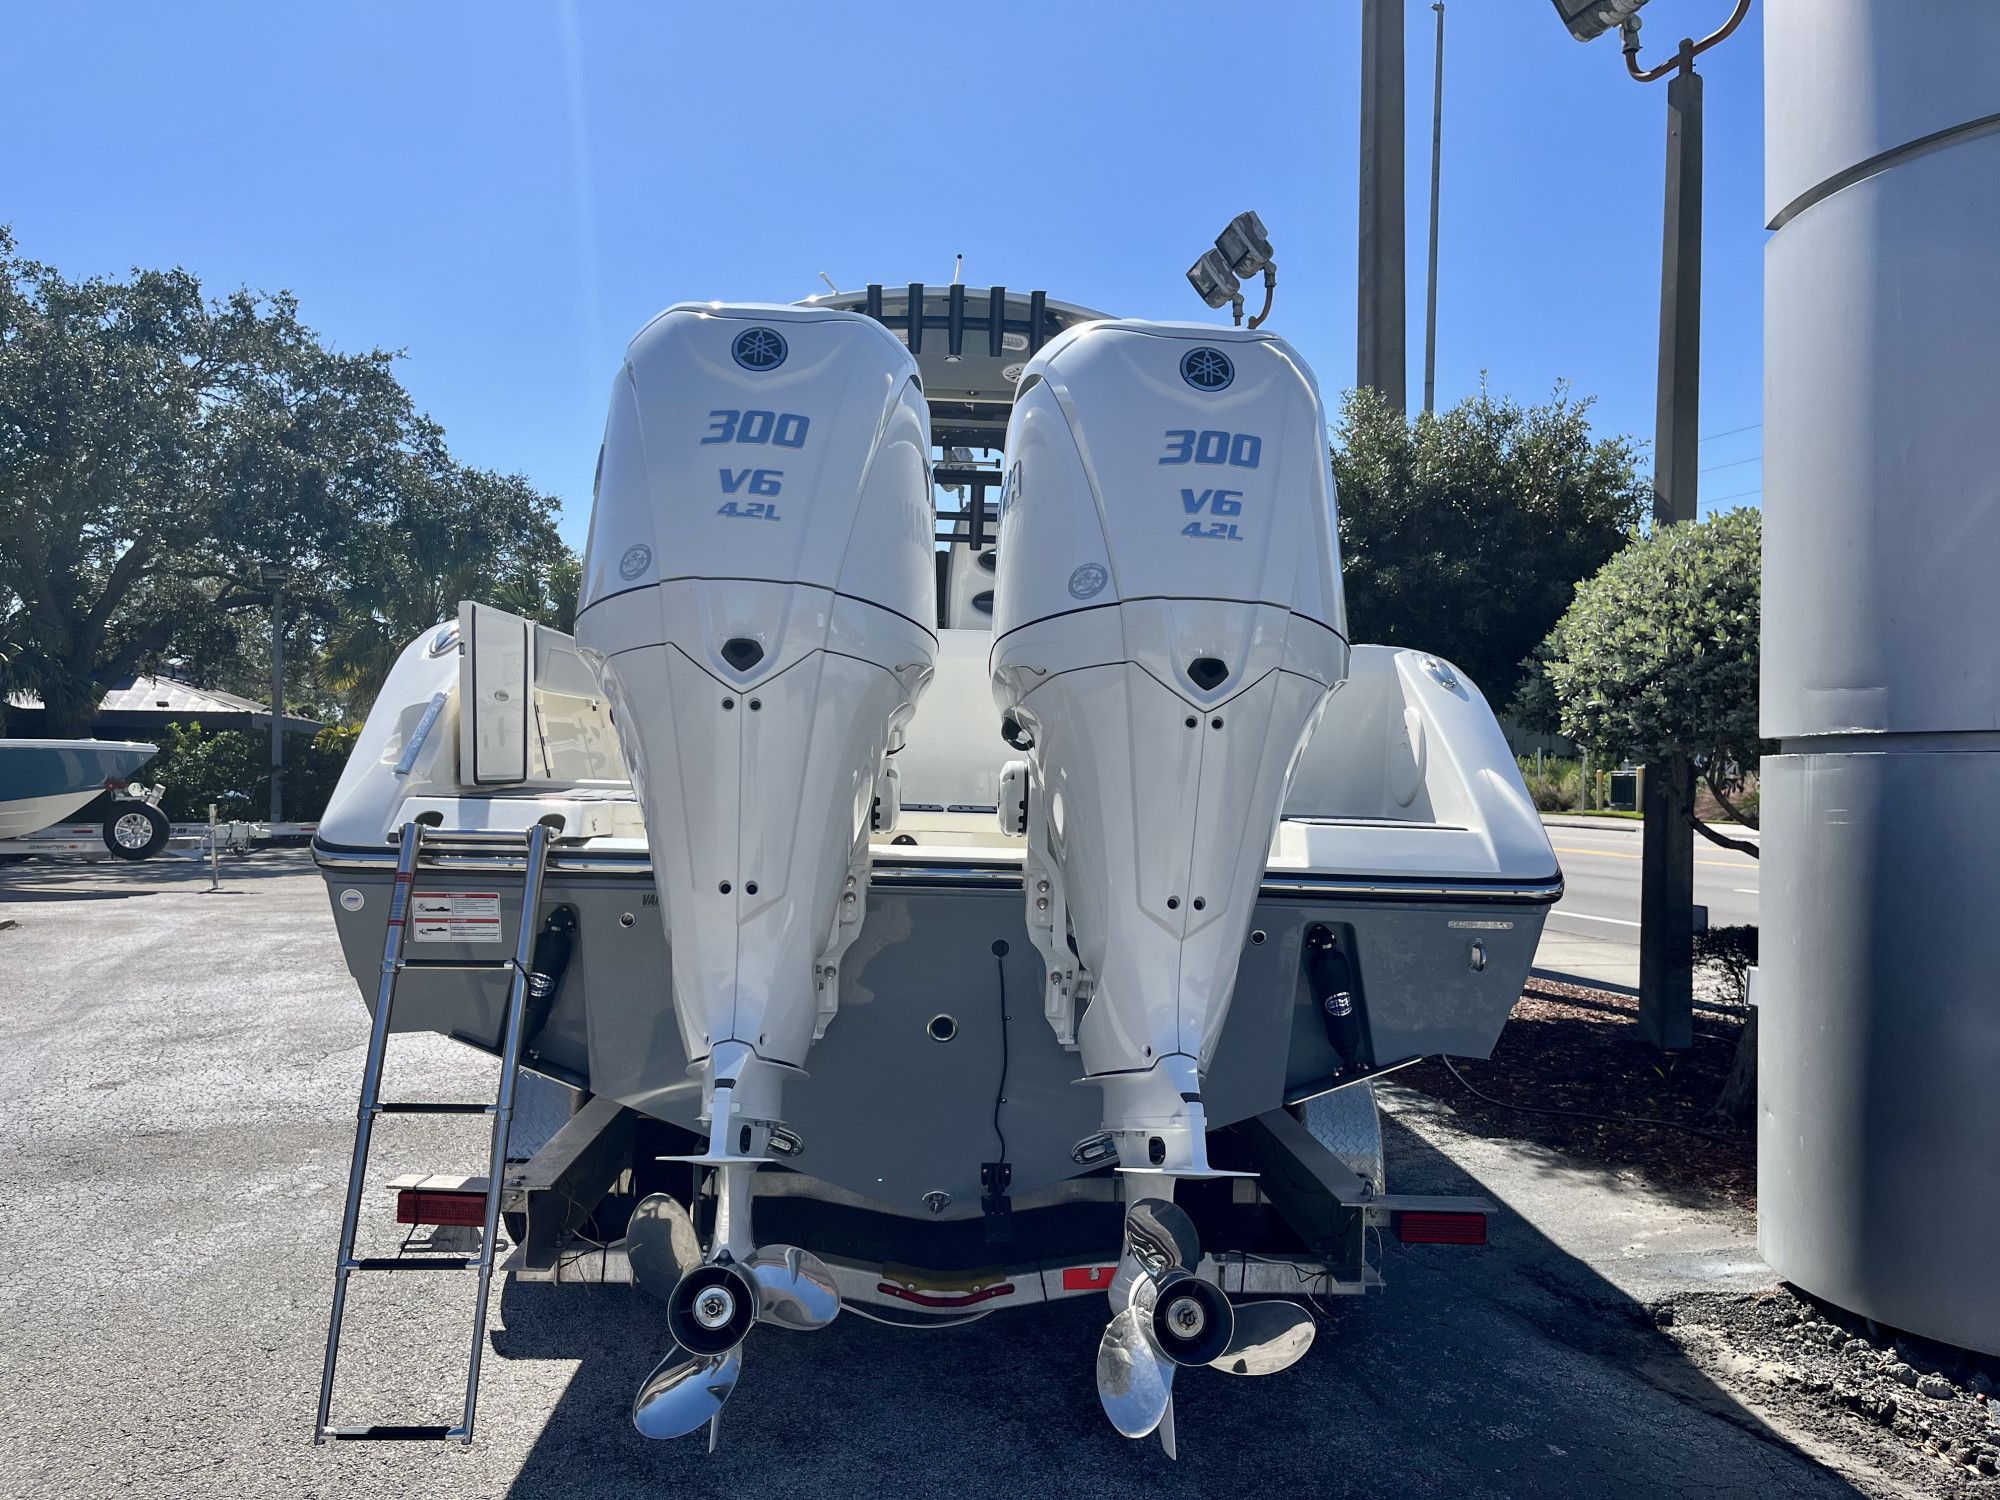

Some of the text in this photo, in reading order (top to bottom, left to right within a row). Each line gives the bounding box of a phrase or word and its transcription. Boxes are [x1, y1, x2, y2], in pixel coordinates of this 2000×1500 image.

[701, 410, 810, 449] 300
[1159, 430, 1262, 469] 300
[719, 468, 784, 497] V6
[717, 501, 782, 521] 4.2L
[1181, 489, 1244, 516] V6
[1181, 522, 1243, 542] 4.2L
